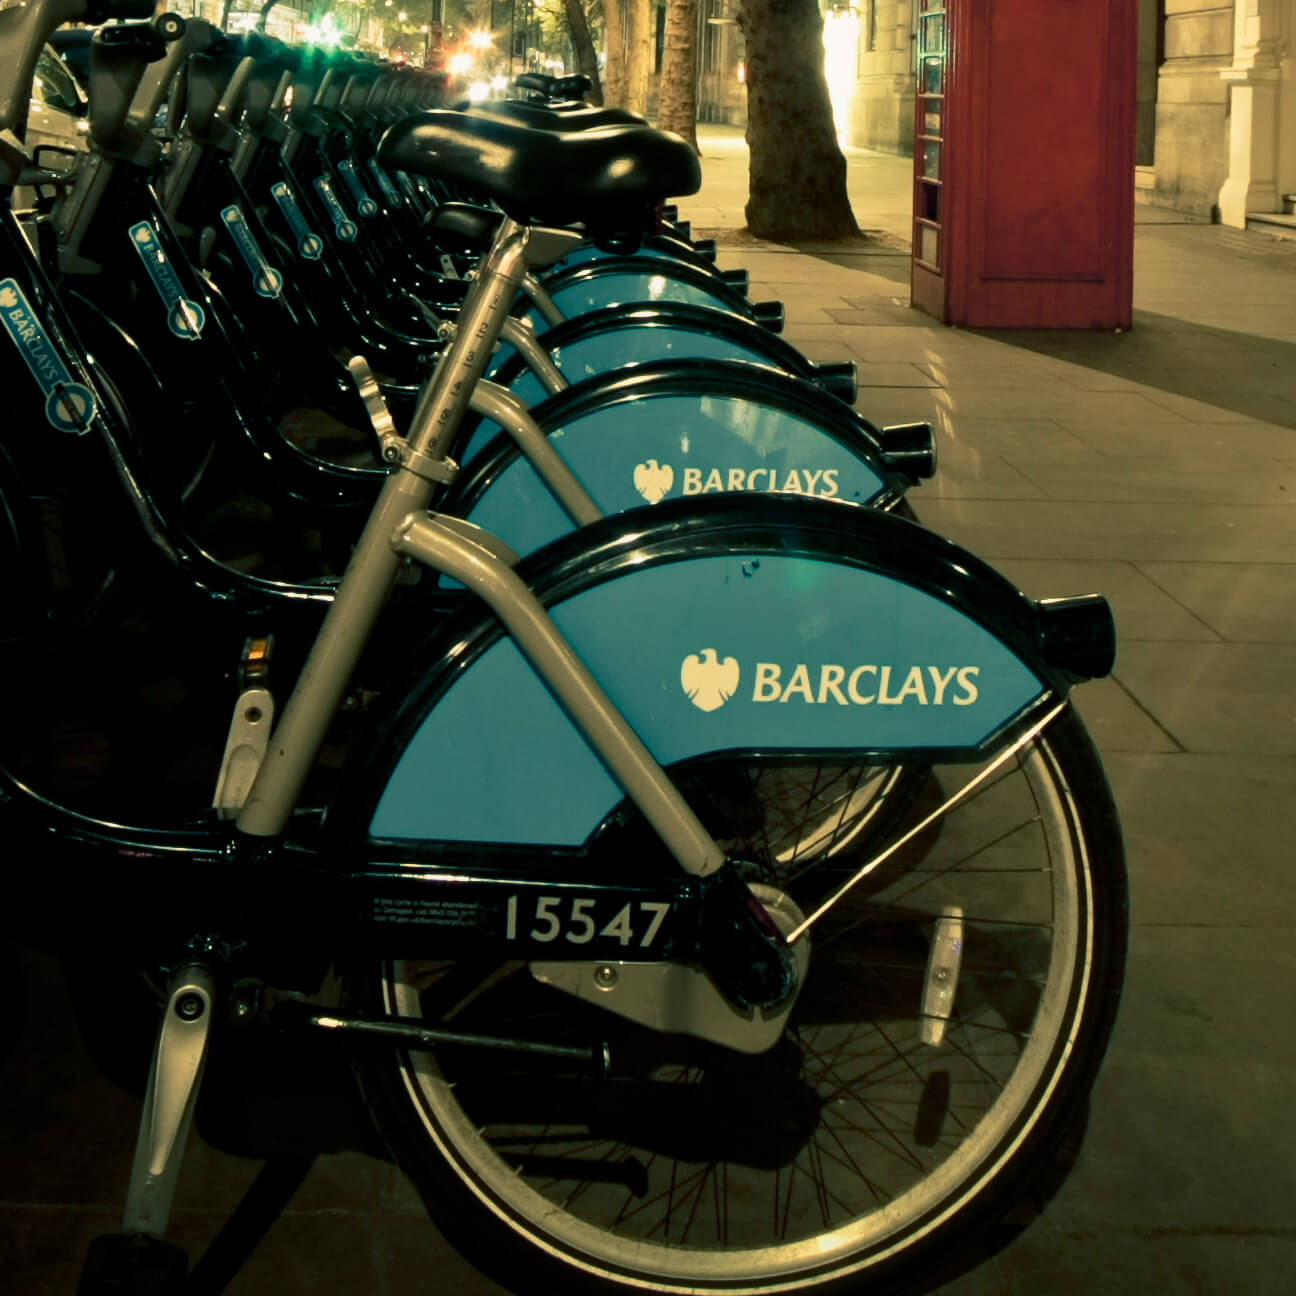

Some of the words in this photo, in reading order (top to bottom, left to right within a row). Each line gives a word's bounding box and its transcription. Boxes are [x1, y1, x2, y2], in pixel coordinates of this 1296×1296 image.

[8, 308, 58, 380] BARCLAYS
[752, 662, 980, 706] BARCLAYS
[505, 894, 671, 948] 15547
